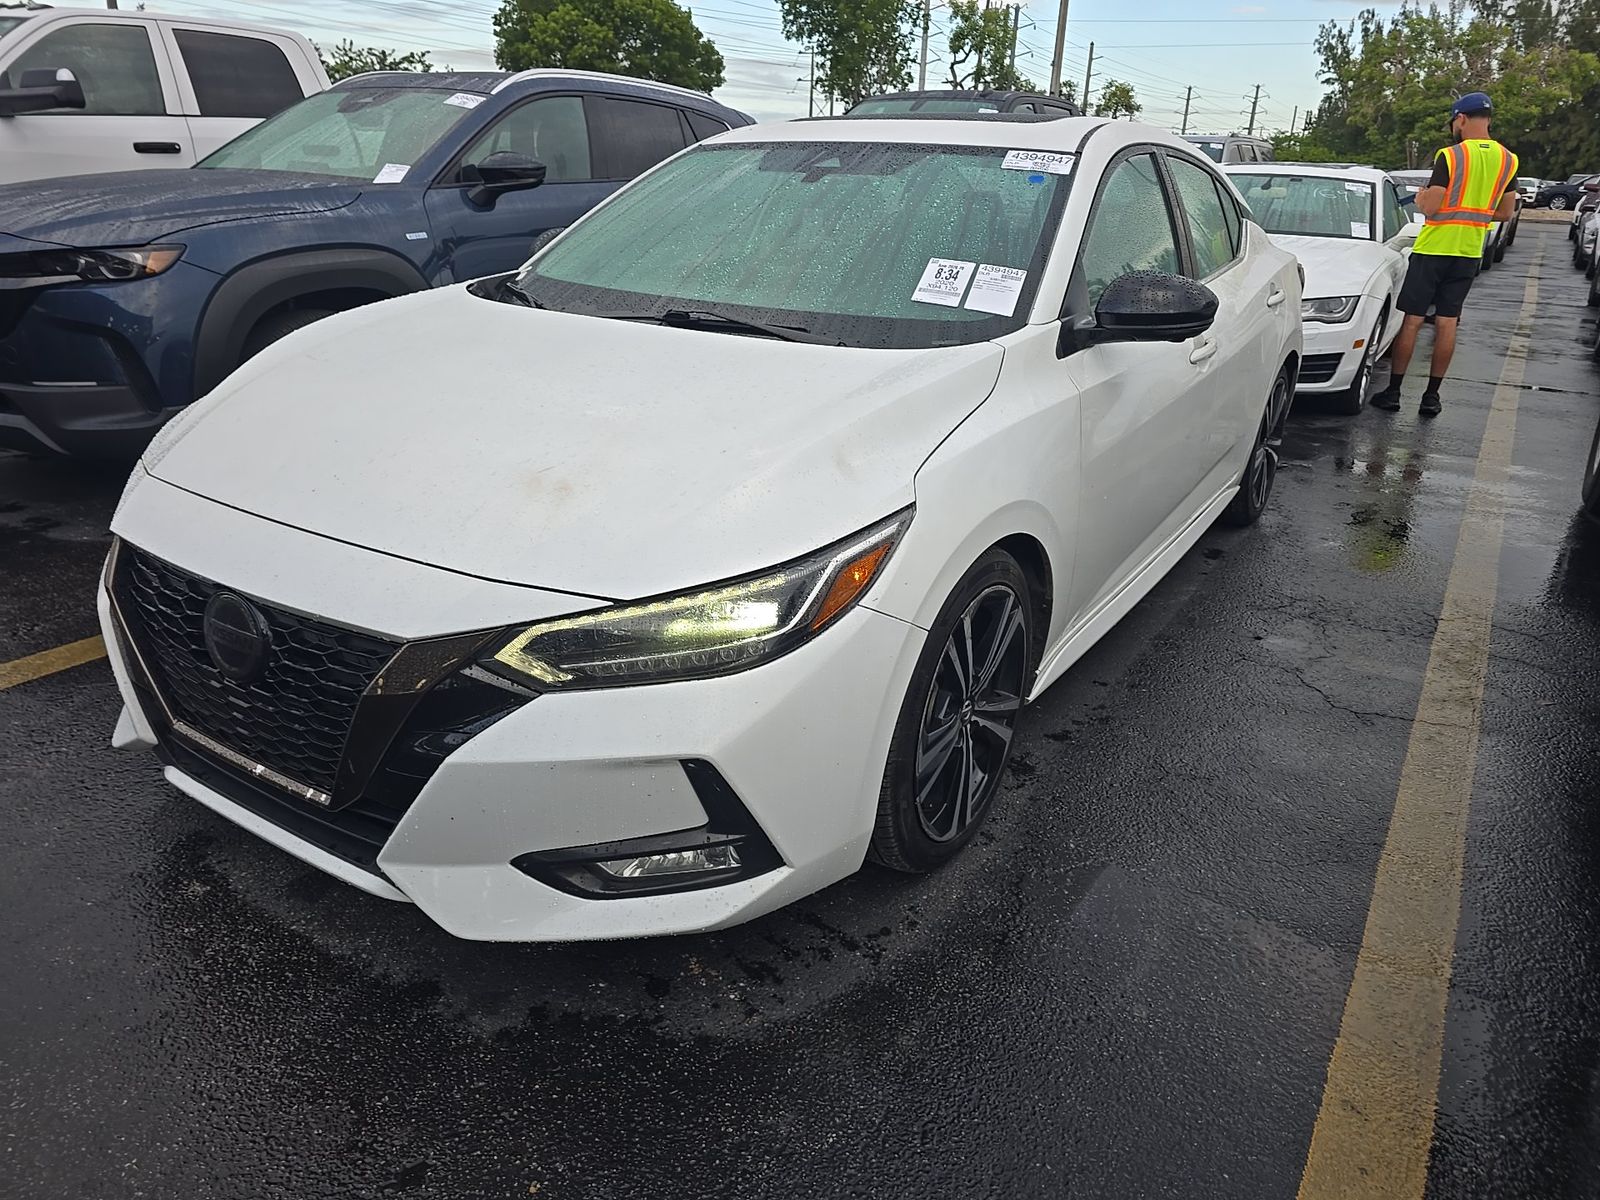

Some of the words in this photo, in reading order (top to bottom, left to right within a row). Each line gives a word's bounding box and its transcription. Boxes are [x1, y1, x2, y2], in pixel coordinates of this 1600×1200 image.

[1011, 152, 1074, 165] 4394947
[934, 267, 960, 281] 8:34
[981, 265, 1026, 277] 4394947
